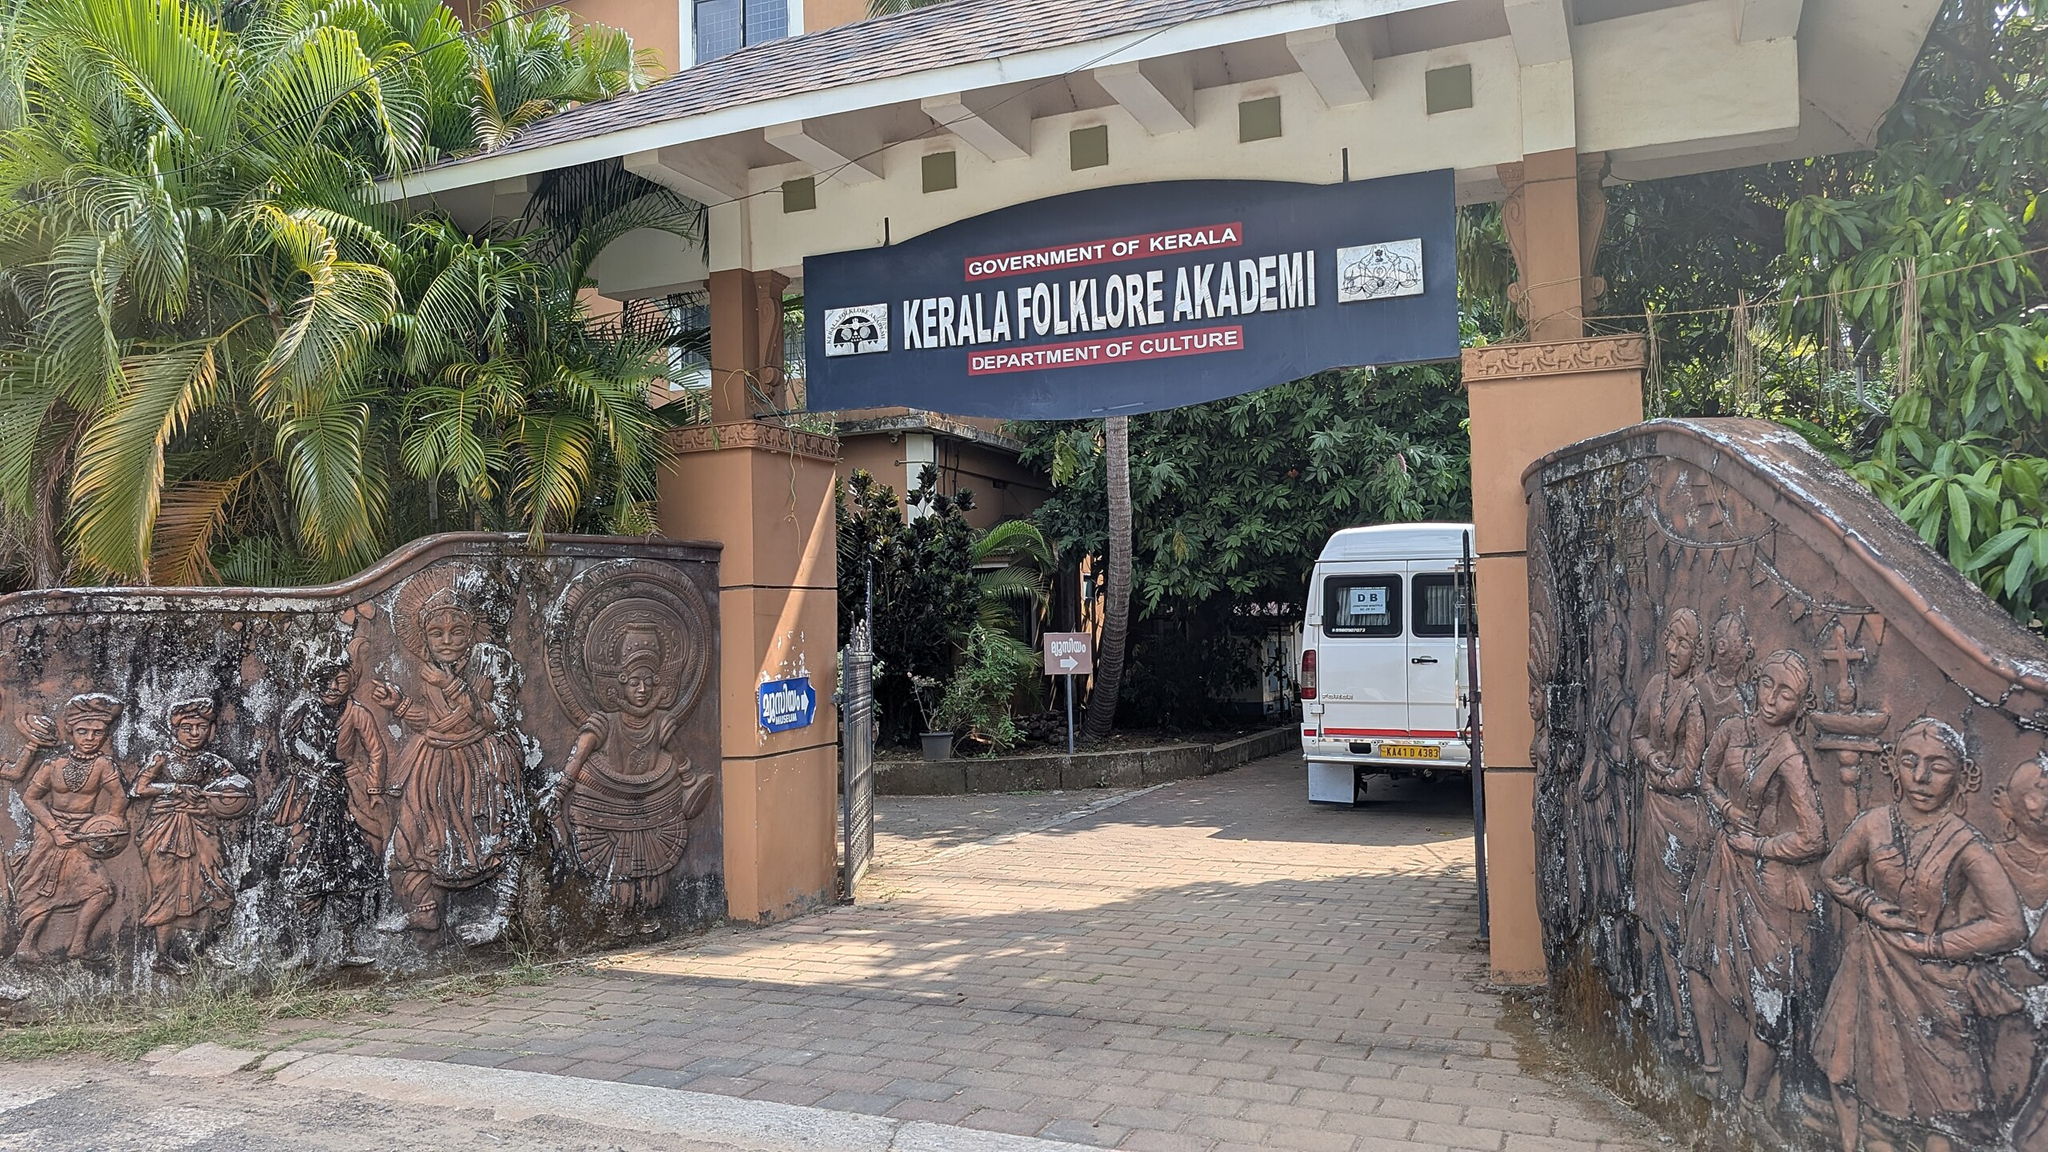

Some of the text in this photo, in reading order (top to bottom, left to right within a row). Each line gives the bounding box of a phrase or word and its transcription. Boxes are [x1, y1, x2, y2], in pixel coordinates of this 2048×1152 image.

[968, 228, 1237, 276] GOVERNMENT OF KERALA
[903, 250, 1316, 350] KERALA FOLKLORE AKADEMI
[972, 330, 1238, 370] DEPARTMENT OF CULTURE
[1357, 593, 1378, 602] D B
[1051, 637, 1086, 657] മ്യൂസിയം
[775, 712, 797, 725] MUSEUM
[1387, 747, 1407, 757] KA41
[1418, 748, 1439, 758] 4383
